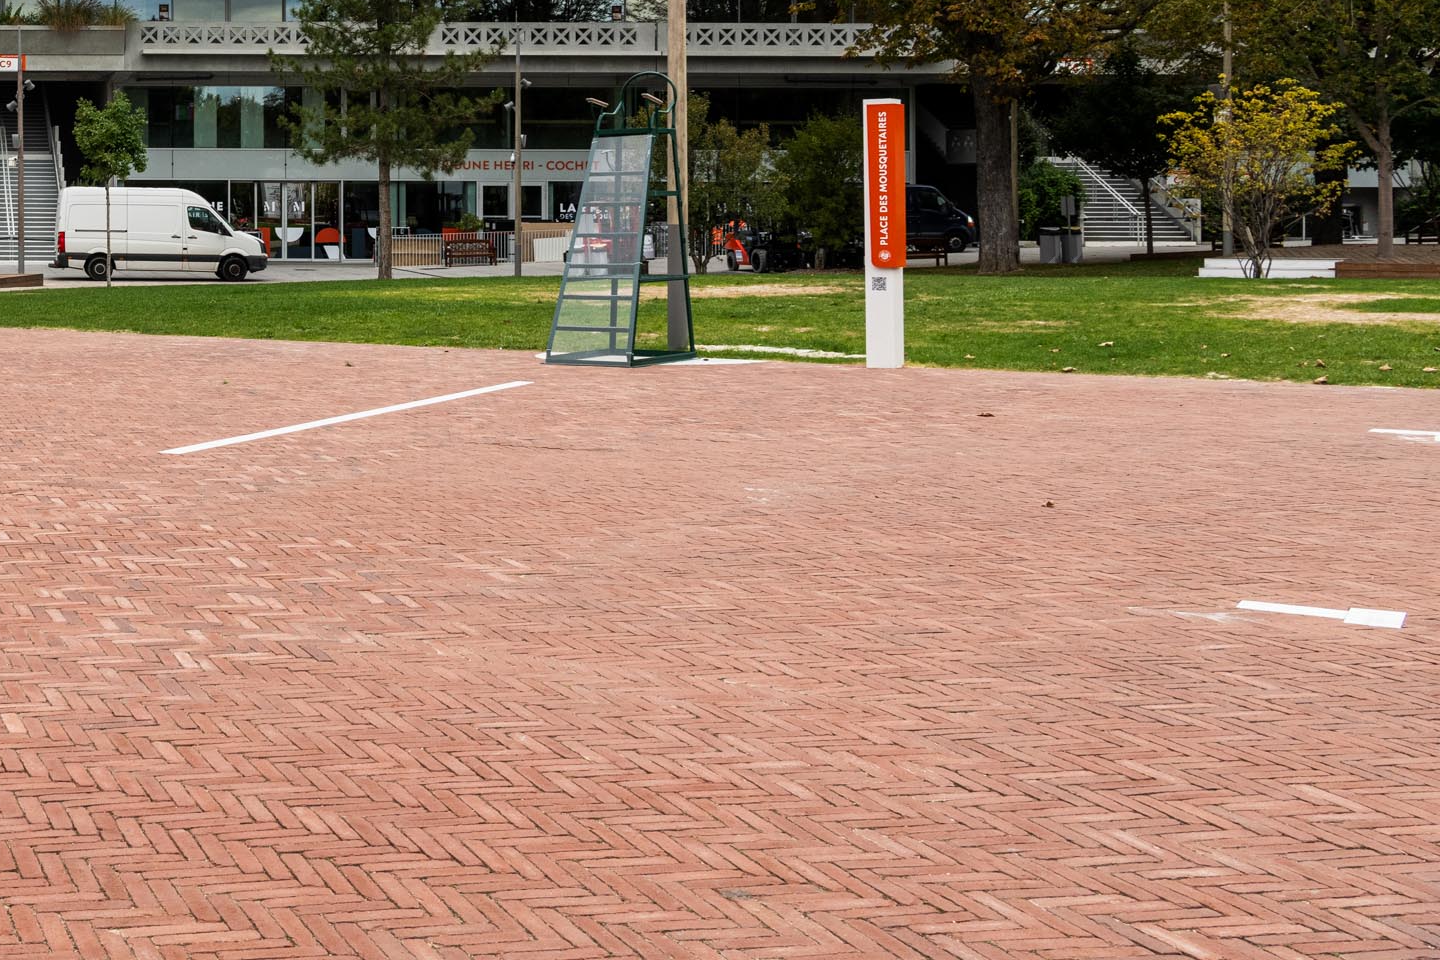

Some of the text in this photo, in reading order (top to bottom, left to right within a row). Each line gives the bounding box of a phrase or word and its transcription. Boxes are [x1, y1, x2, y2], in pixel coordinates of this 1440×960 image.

[0, 60, 12, 68] C9
[878, 111, 889, 193] MOUSQUETAIRES
[493, 160, 535, 170] HERI
[879, 195, 889, 213] DES
[879, 215, 889, 246] PLACE
